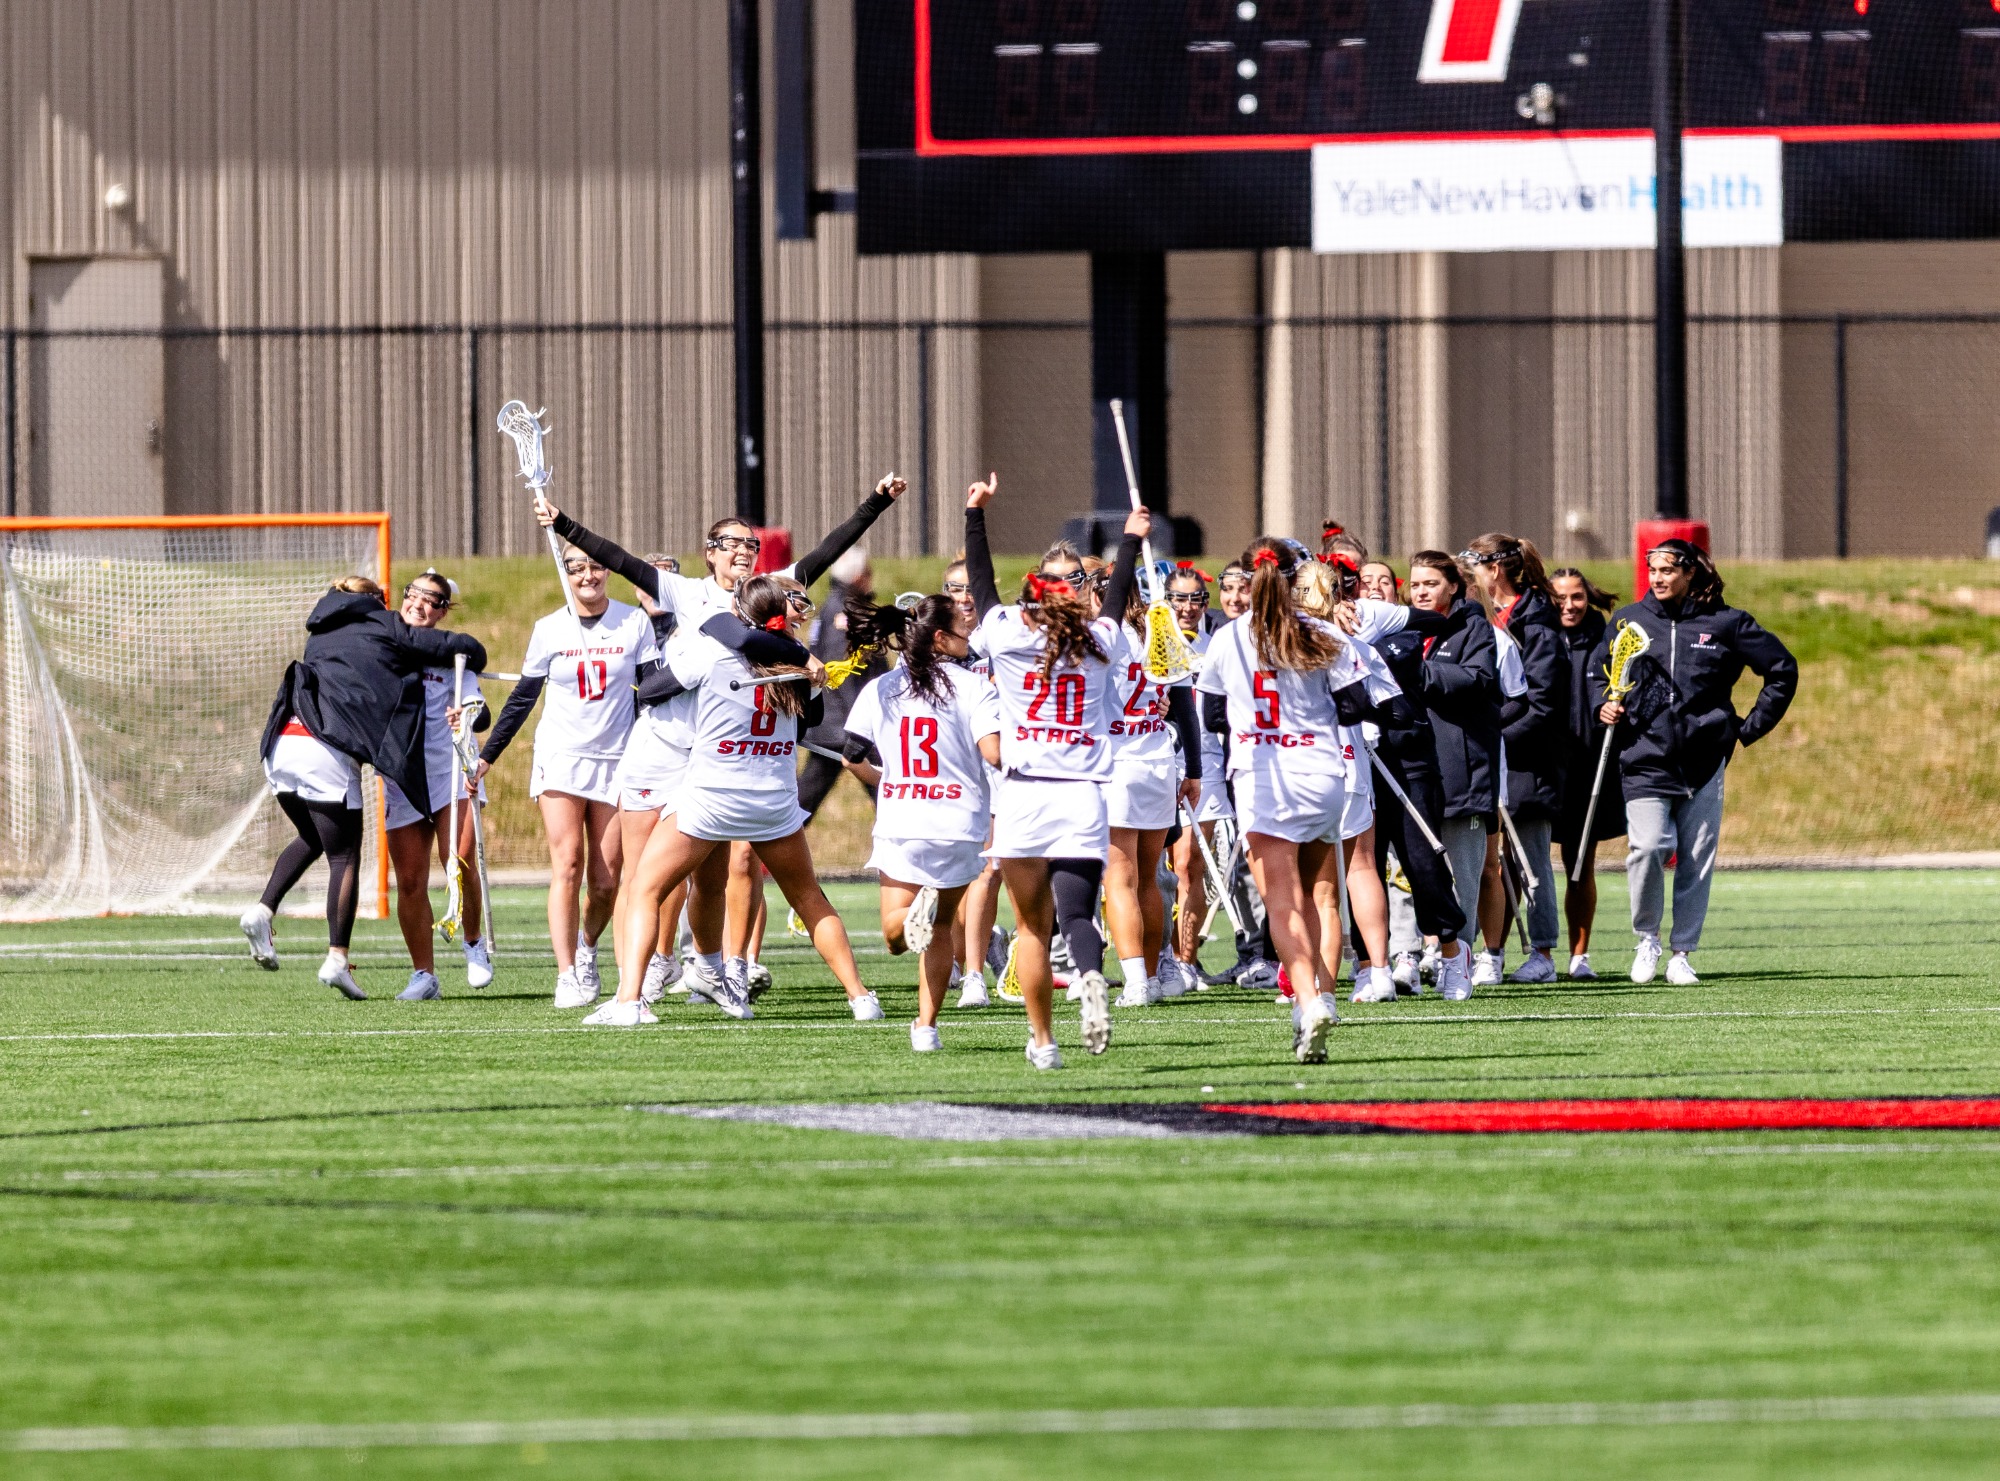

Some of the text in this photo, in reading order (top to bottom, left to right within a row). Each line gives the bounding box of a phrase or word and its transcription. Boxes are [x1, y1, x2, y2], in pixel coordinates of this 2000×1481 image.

[1333, 174, 1763, 217] YaleNewHavenHalth
[577, 660, 607, 700] 10
[1023, 671, 1086, 727] 20
[1253, 670, 1280, 729] 5
[750, 684, 777, 737] 8
[717, 740, 795, 756] STAGS
[899, 716, 939, 778] 13
[1016, 725, 1096, 747] STAGS
[882, 782, 963, 800] STAGS
